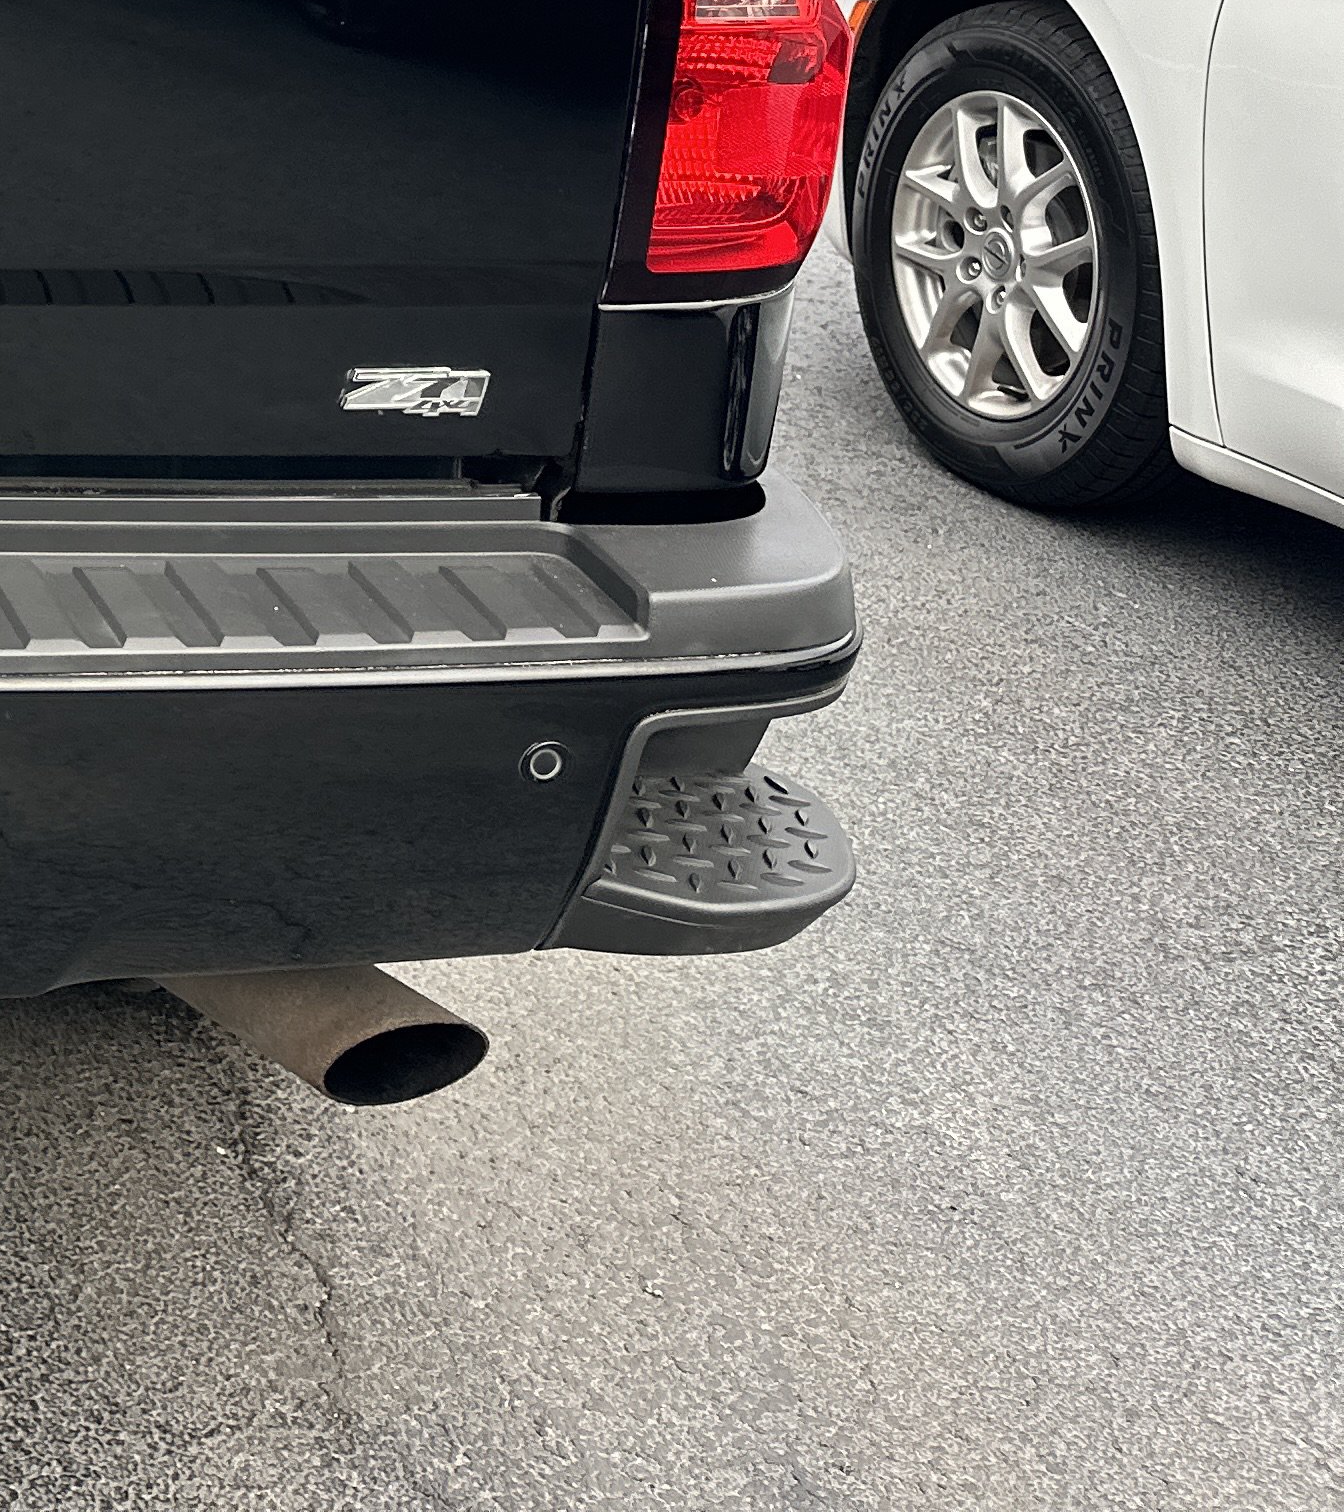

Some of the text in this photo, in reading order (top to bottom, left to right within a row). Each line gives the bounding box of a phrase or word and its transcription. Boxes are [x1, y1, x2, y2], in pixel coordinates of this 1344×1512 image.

[857, 69, 908, 200] PRINX
[339, 366, 491, 412] Z71
[1057, 317, 1123, 454] PRINX
